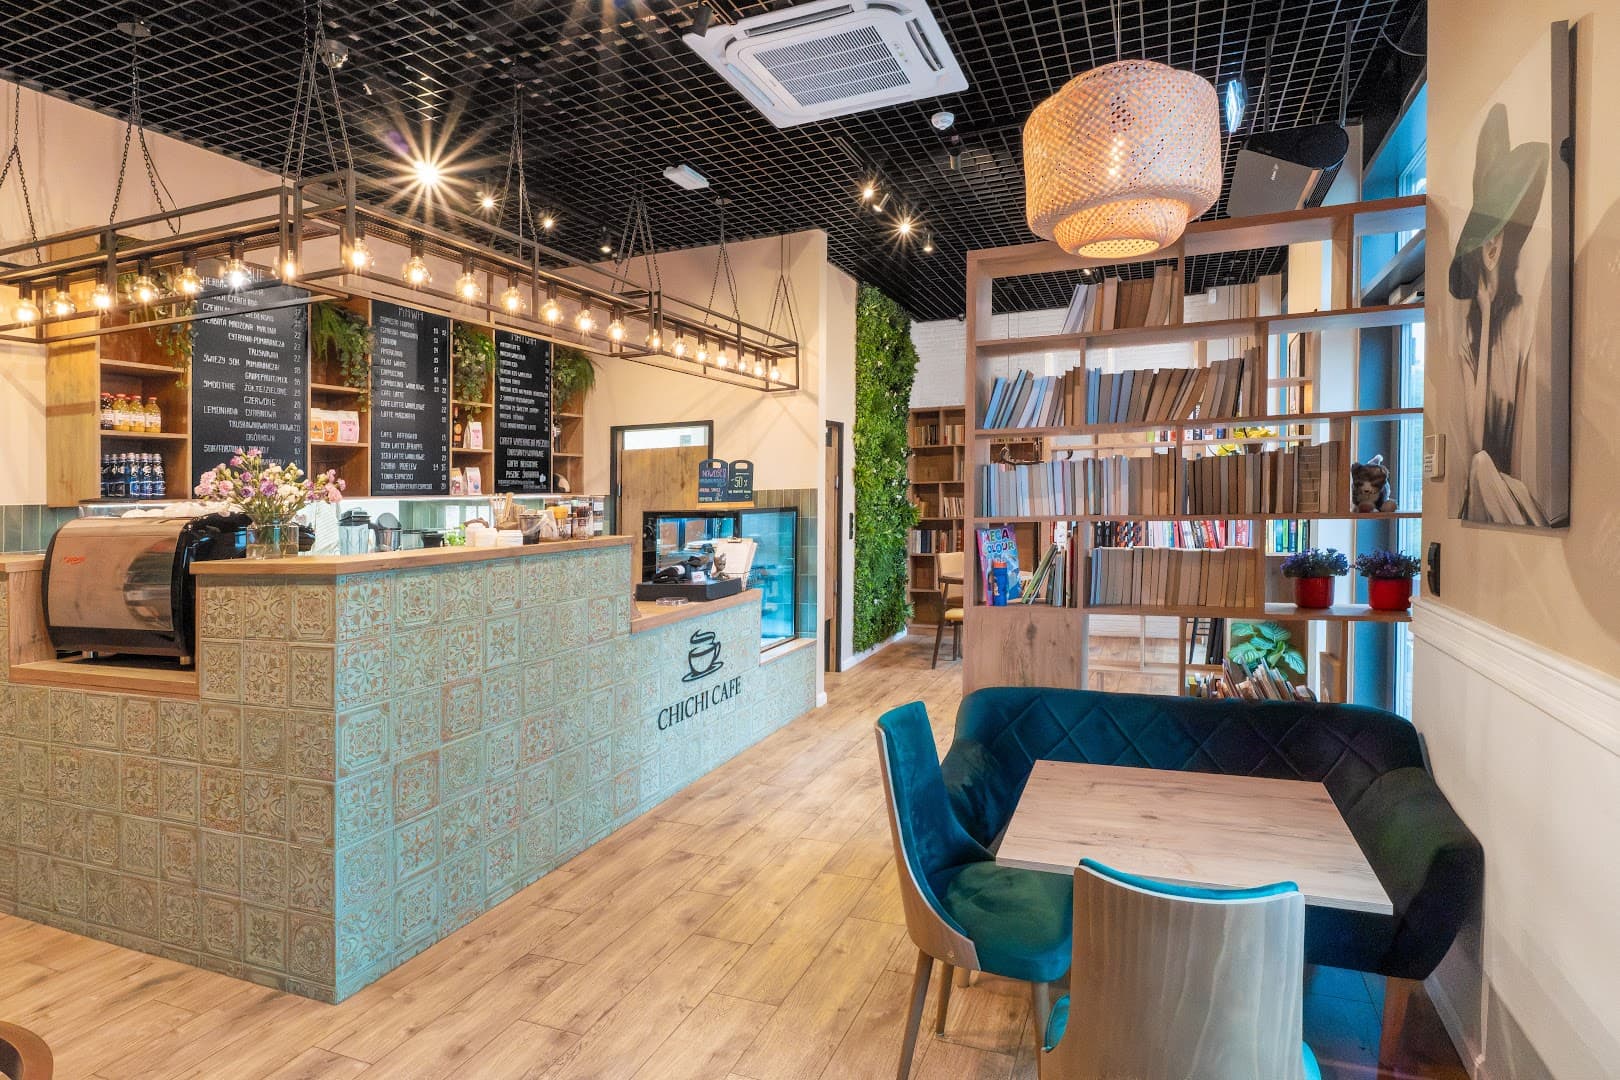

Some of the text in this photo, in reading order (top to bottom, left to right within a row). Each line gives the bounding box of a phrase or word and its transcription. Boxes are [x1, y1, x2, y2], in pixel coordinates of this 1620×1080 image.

[203, 379, 237, 391] SMOOTHIE
[243, 396, 276, 406] CZERWONE
[203, 405, 238, 415] LEMONIADA
[657, 676, 742, 731] CHICHI CAFE
